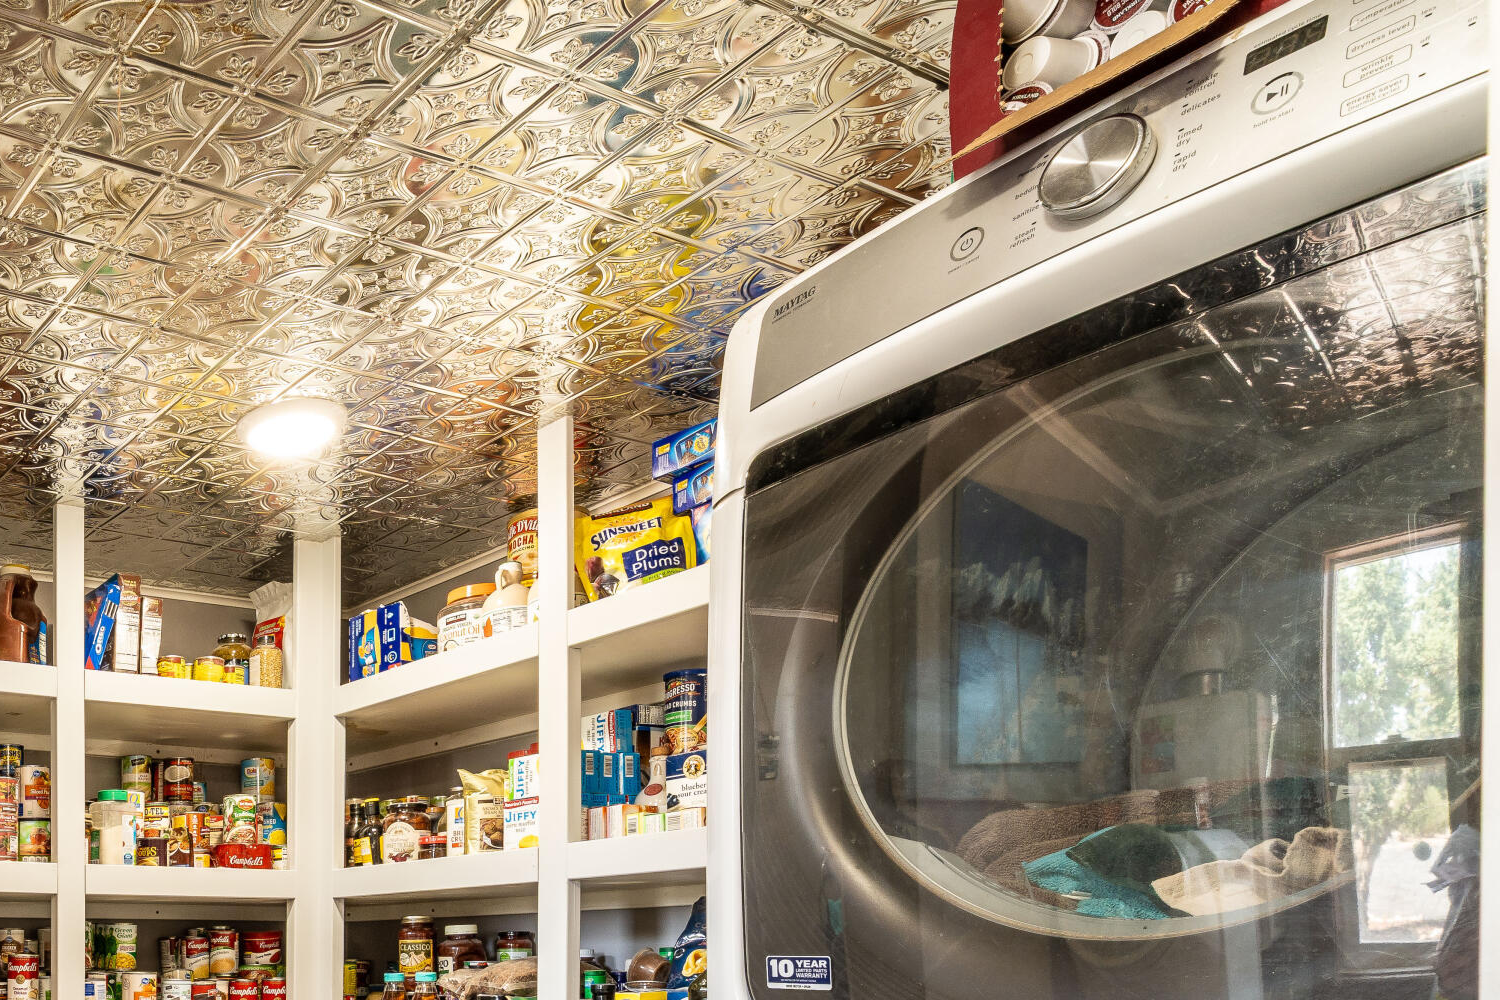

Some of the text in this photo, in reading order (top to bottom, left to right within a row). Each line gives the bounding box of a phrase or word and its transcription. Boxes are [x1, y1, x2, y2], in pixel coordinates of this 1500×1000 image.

[1350, 21, 1411, 53] dryness level
[1360, 54, 1395, 73] wrinkle
[1184, 80, 1217, 99] control
[1185, 72, 1219, 91] wrinkle
[1180, 93, 1221, 116] delicates
[1177, 124, 1203, 141] timed
[1176, 138, 1191, 149] dry
[1173, 150, 1197, 165] rapid
[1172, 162, 1187, 173] dry
[1012, 204, 1040, 221] sanitize
[1009, 234, 1035, 249] refresh
[1014, 227, 1036, 241] steam
[773, 286, 816, 319] MAYTAG
[590, 516, 662, 552] SUNSWEET
[636, 541, 679, 562] Dried
[632, 554, 681, 575] Plums
[94, 625, 106, 654] OREO
[468, 626, 480, 636] Oil
[672, 700, 697, 708] CRUMBS
[595, 714, 607, 752] JIFFY
[0, 746, 21, 759] BUSH'S
[515, 758, 526, 797] JIFFY
[681, 782, 707, 792] blueber
[692, 788, 707, 796] crea
[505, 809, 537, 823] JIFFY
[229, 855, 263, 866] Campbell's
[400, 943, 431, 952] CLASSICO
[769, 958, 827, 979] 10 YEAR
